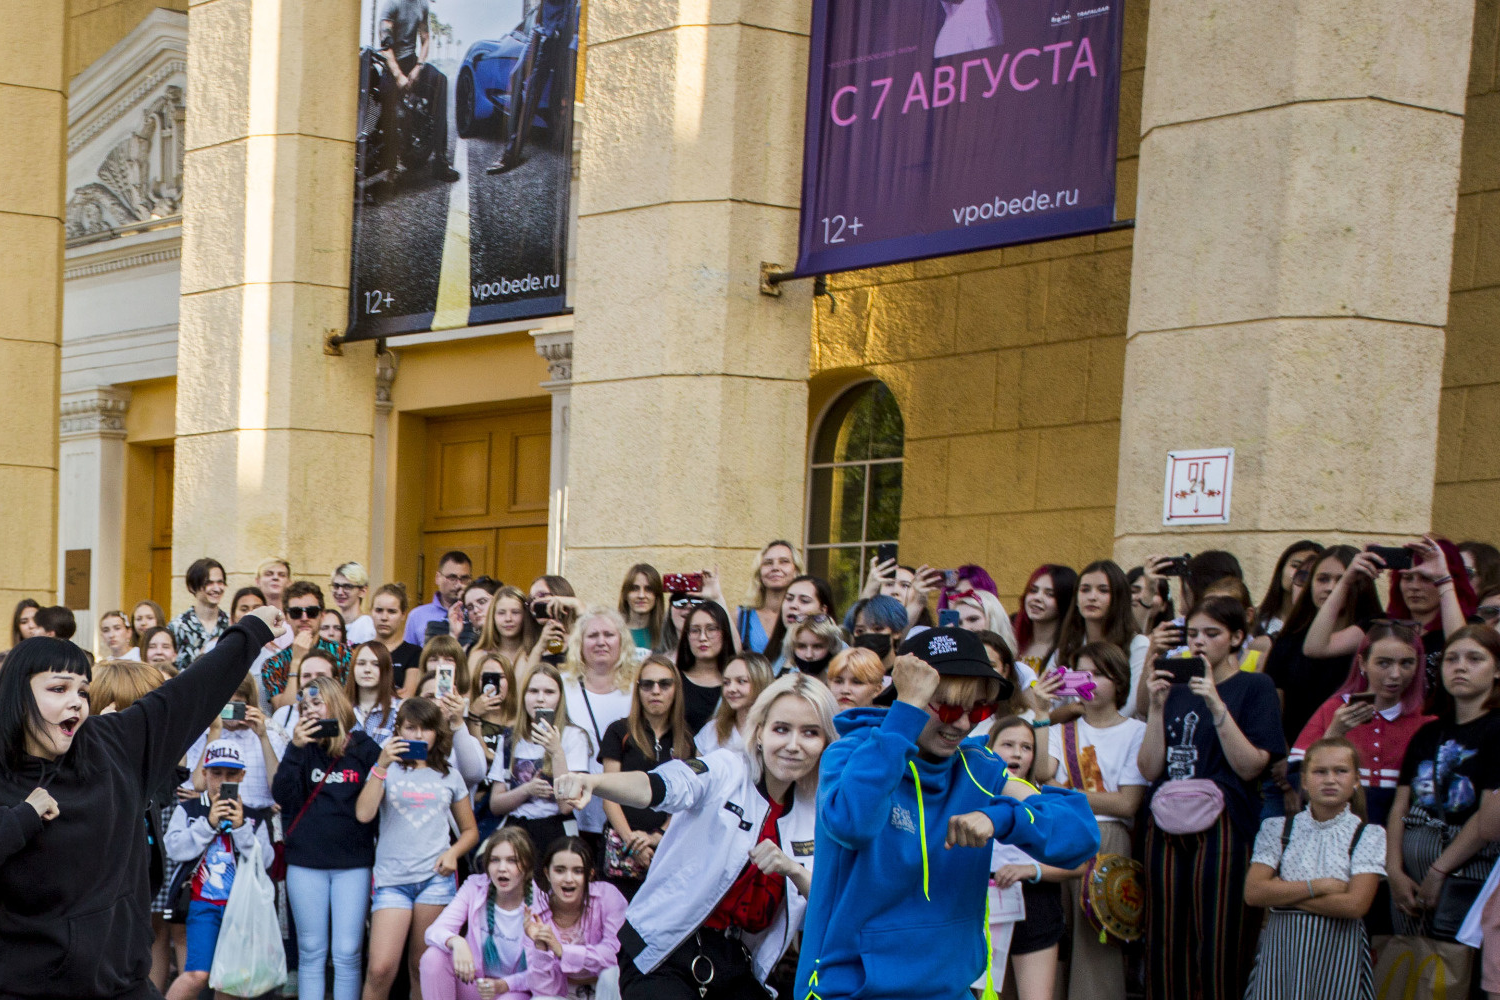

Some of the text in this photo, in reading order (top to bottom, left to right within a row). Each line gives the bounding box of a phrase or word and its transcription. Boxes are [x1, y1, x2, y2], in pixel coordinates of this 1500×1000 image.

[830, 85, 858, 127] С
[870, 77, 893, 120] 7
[901, 37, 1097, 114] АВГУСТА
[952, 188, 1079, 226] vpobede.ru
[821, 215, 864, 245] 12+
[471, 273, 560, 300] vpobede.ru
[364, 289, 395, 315] 12+
